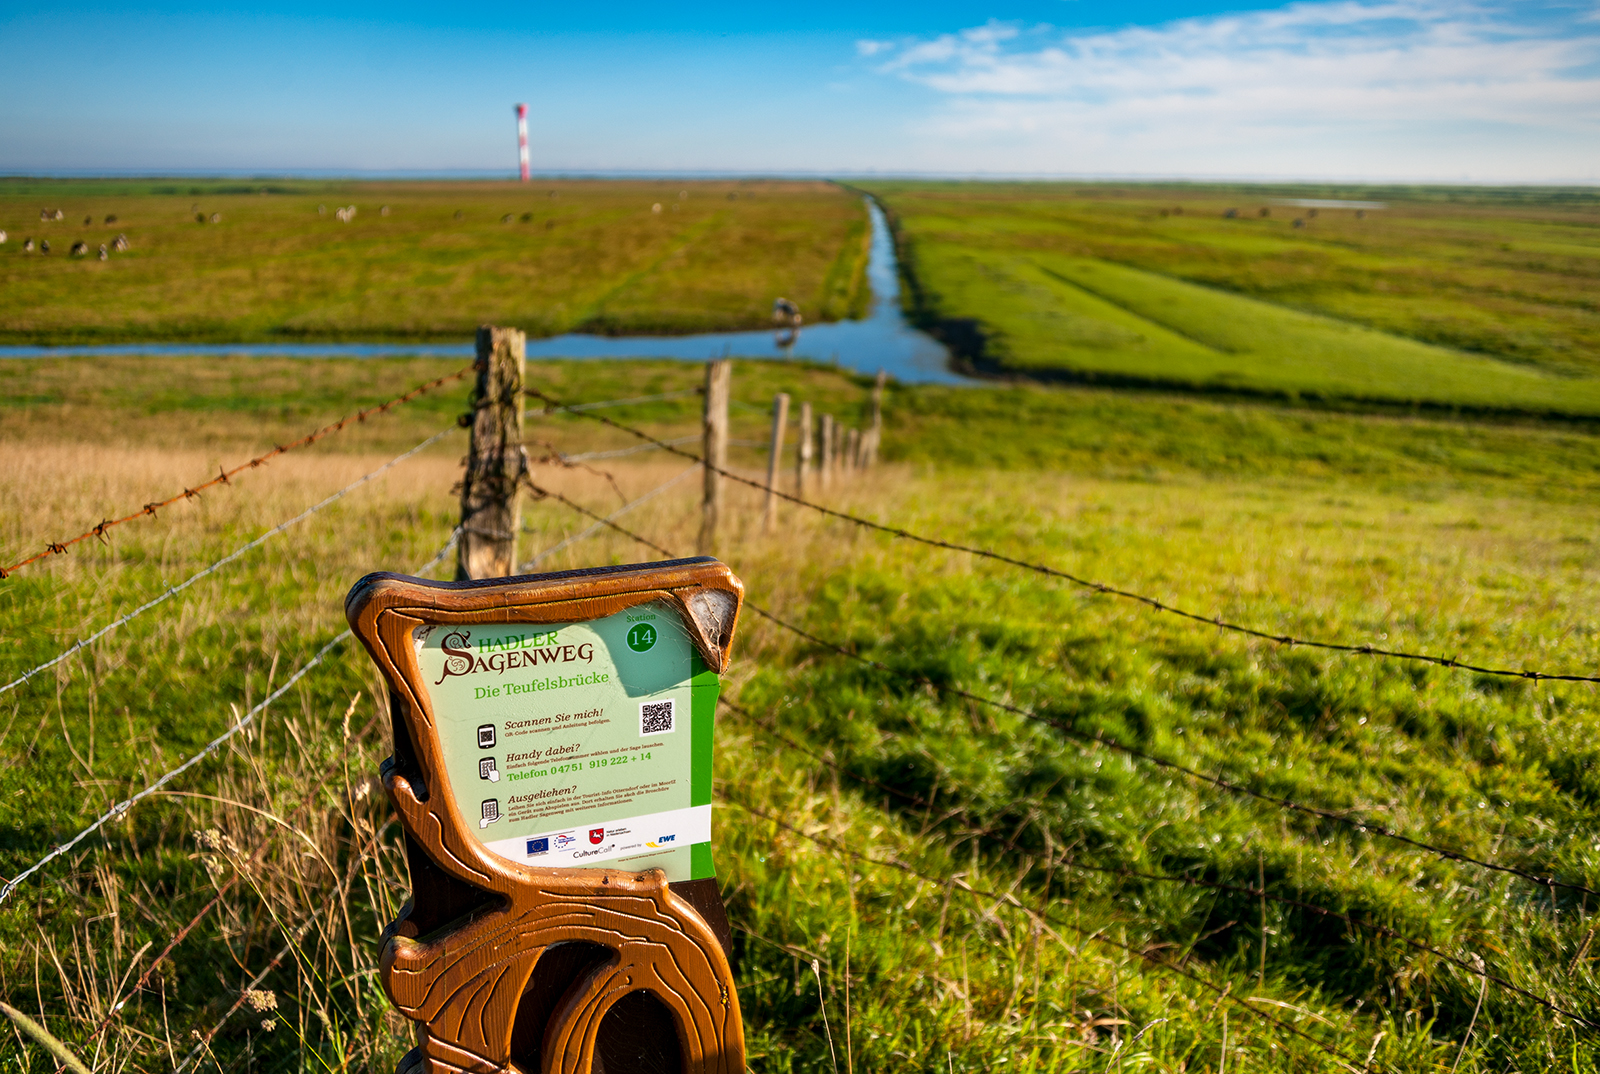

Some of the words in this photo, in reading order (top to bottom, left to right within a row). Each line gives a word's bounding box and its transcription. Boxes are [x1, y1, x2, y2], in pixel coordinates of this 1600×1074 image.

[627, 613, 656, 622] Station
[479, 631, 559, 653] HADLER
[632, 630, 653, 646] 14
[435, 631, 594, 685] SAGENWEG
[474, 687, 500, 699] Die
[503, 672, 609, 696] Teufelsbrücke
[505, 717, 552, 730] Scannen
[555, 713, 570, 723] Sie
[574, 708, 603, 720] mich!
[506, 750, 543, 762] Handy
[545, 744, 580, 756] dabei?
[506, 769, 547, 781] Telefon
[550, 763, 582, 774] 04751
[589, 759, 607, 769] 919
[610, 756, 628, 766] 222
[640, 752, 651, 760] 14
[508, 785, 577, 804] Ausgeliehen?
[613, 785, 639, 794] Otterndorf
[597, 798, 632, 807] Informationen.
[658, 834, 675, 843] EWE
[573, 846, 612, 859] CultureCall
